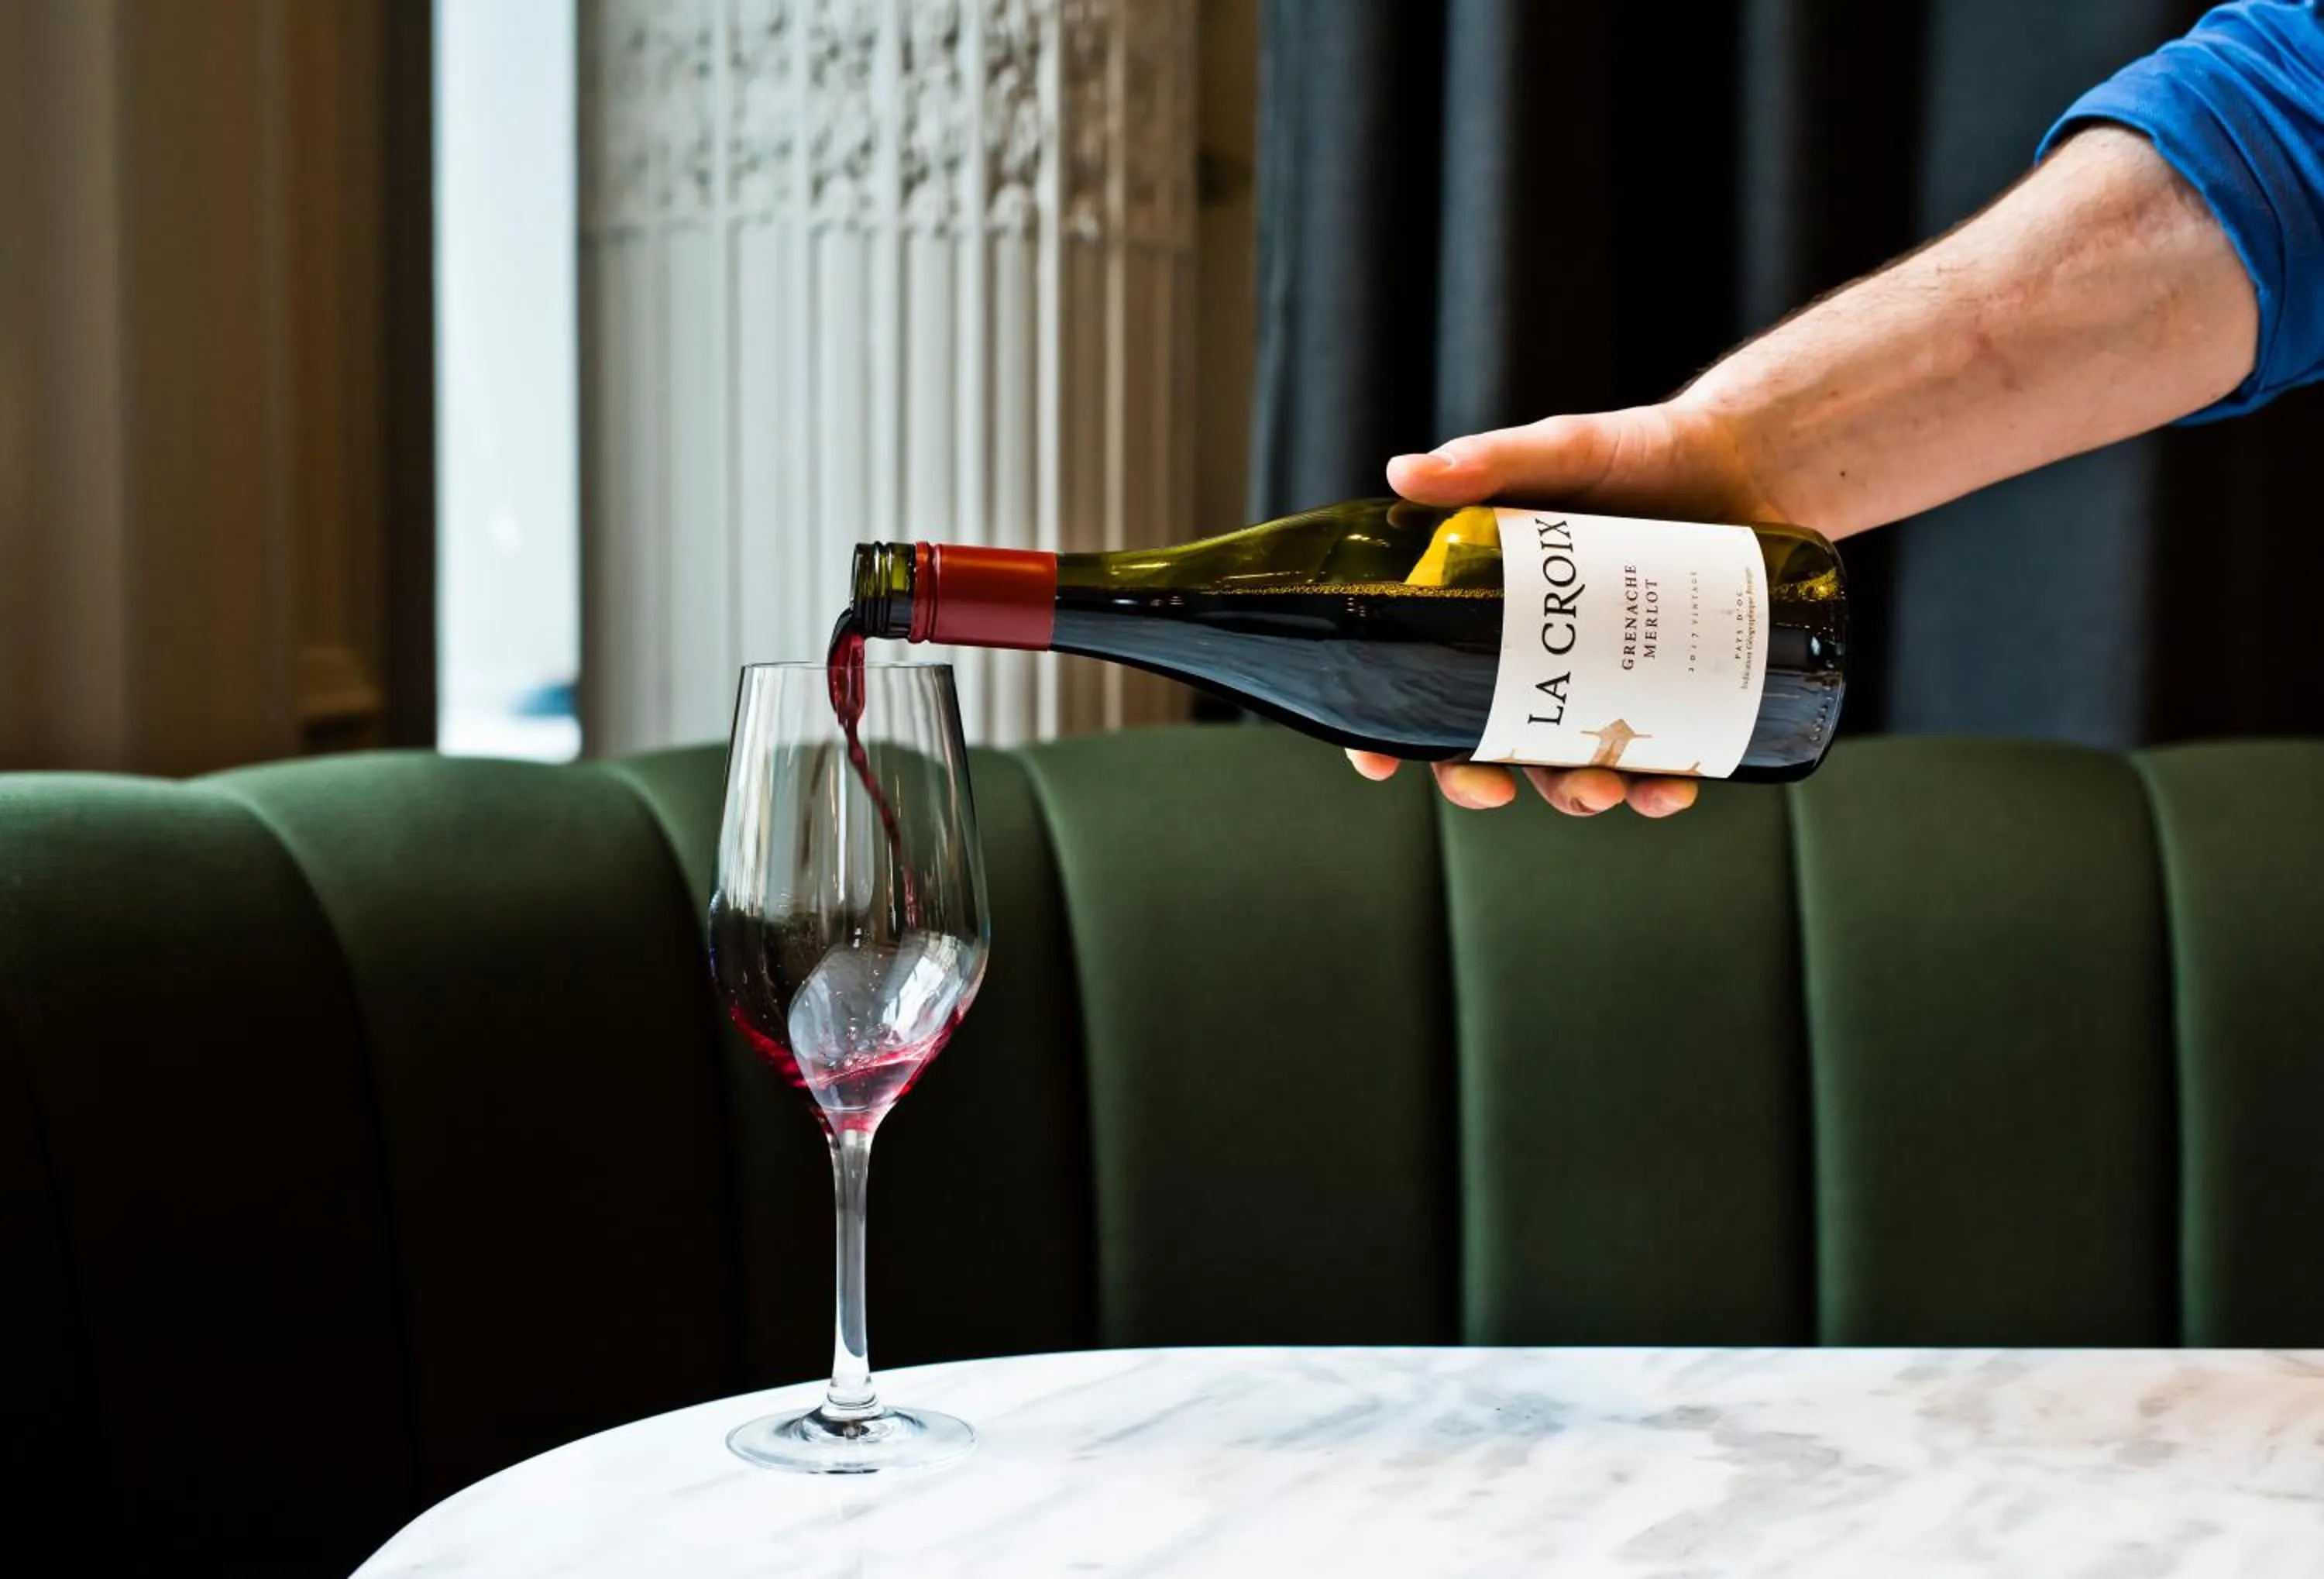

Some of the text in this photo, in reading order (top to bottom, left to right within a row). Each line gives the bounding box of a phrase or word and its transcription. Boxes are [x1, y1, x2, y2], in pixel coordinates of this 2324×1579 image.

[1528, 518, 1586, 725] LA CROIX
[1621, 564, 1640, 671] GRENACHE
[1643, 579, 1659, 659] MERLOT
[1690, 572, 1699, 624] VINTAGE
[1735, 630, 1744, 659] PAYS
